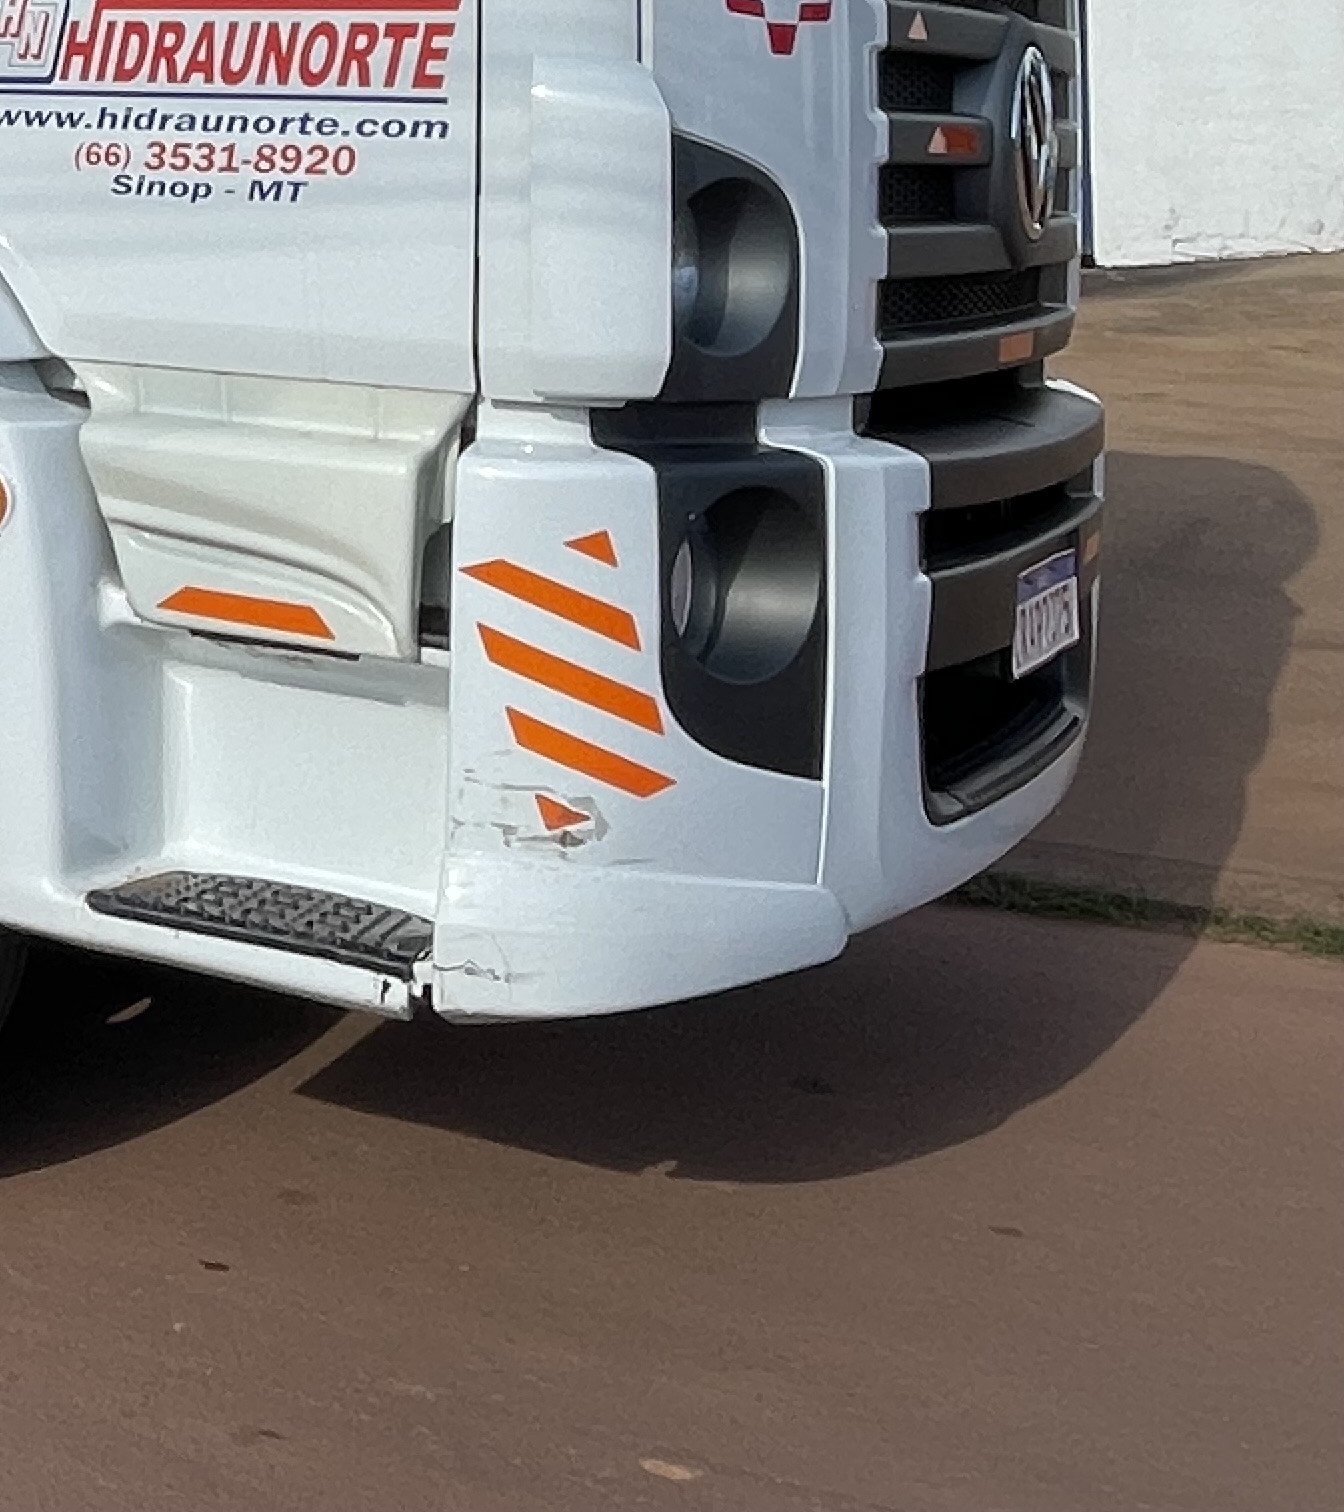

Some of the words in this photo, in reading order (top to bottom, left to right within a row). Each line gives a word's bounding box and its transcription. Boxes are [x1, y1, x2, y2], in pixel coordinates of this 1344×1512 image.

[74, 142, 132, 172] (66)
[144, 142, 357, 176] 3531-8920
[110, 174, 212, 203] Sinop
[247, 180, 309, 203] MT
